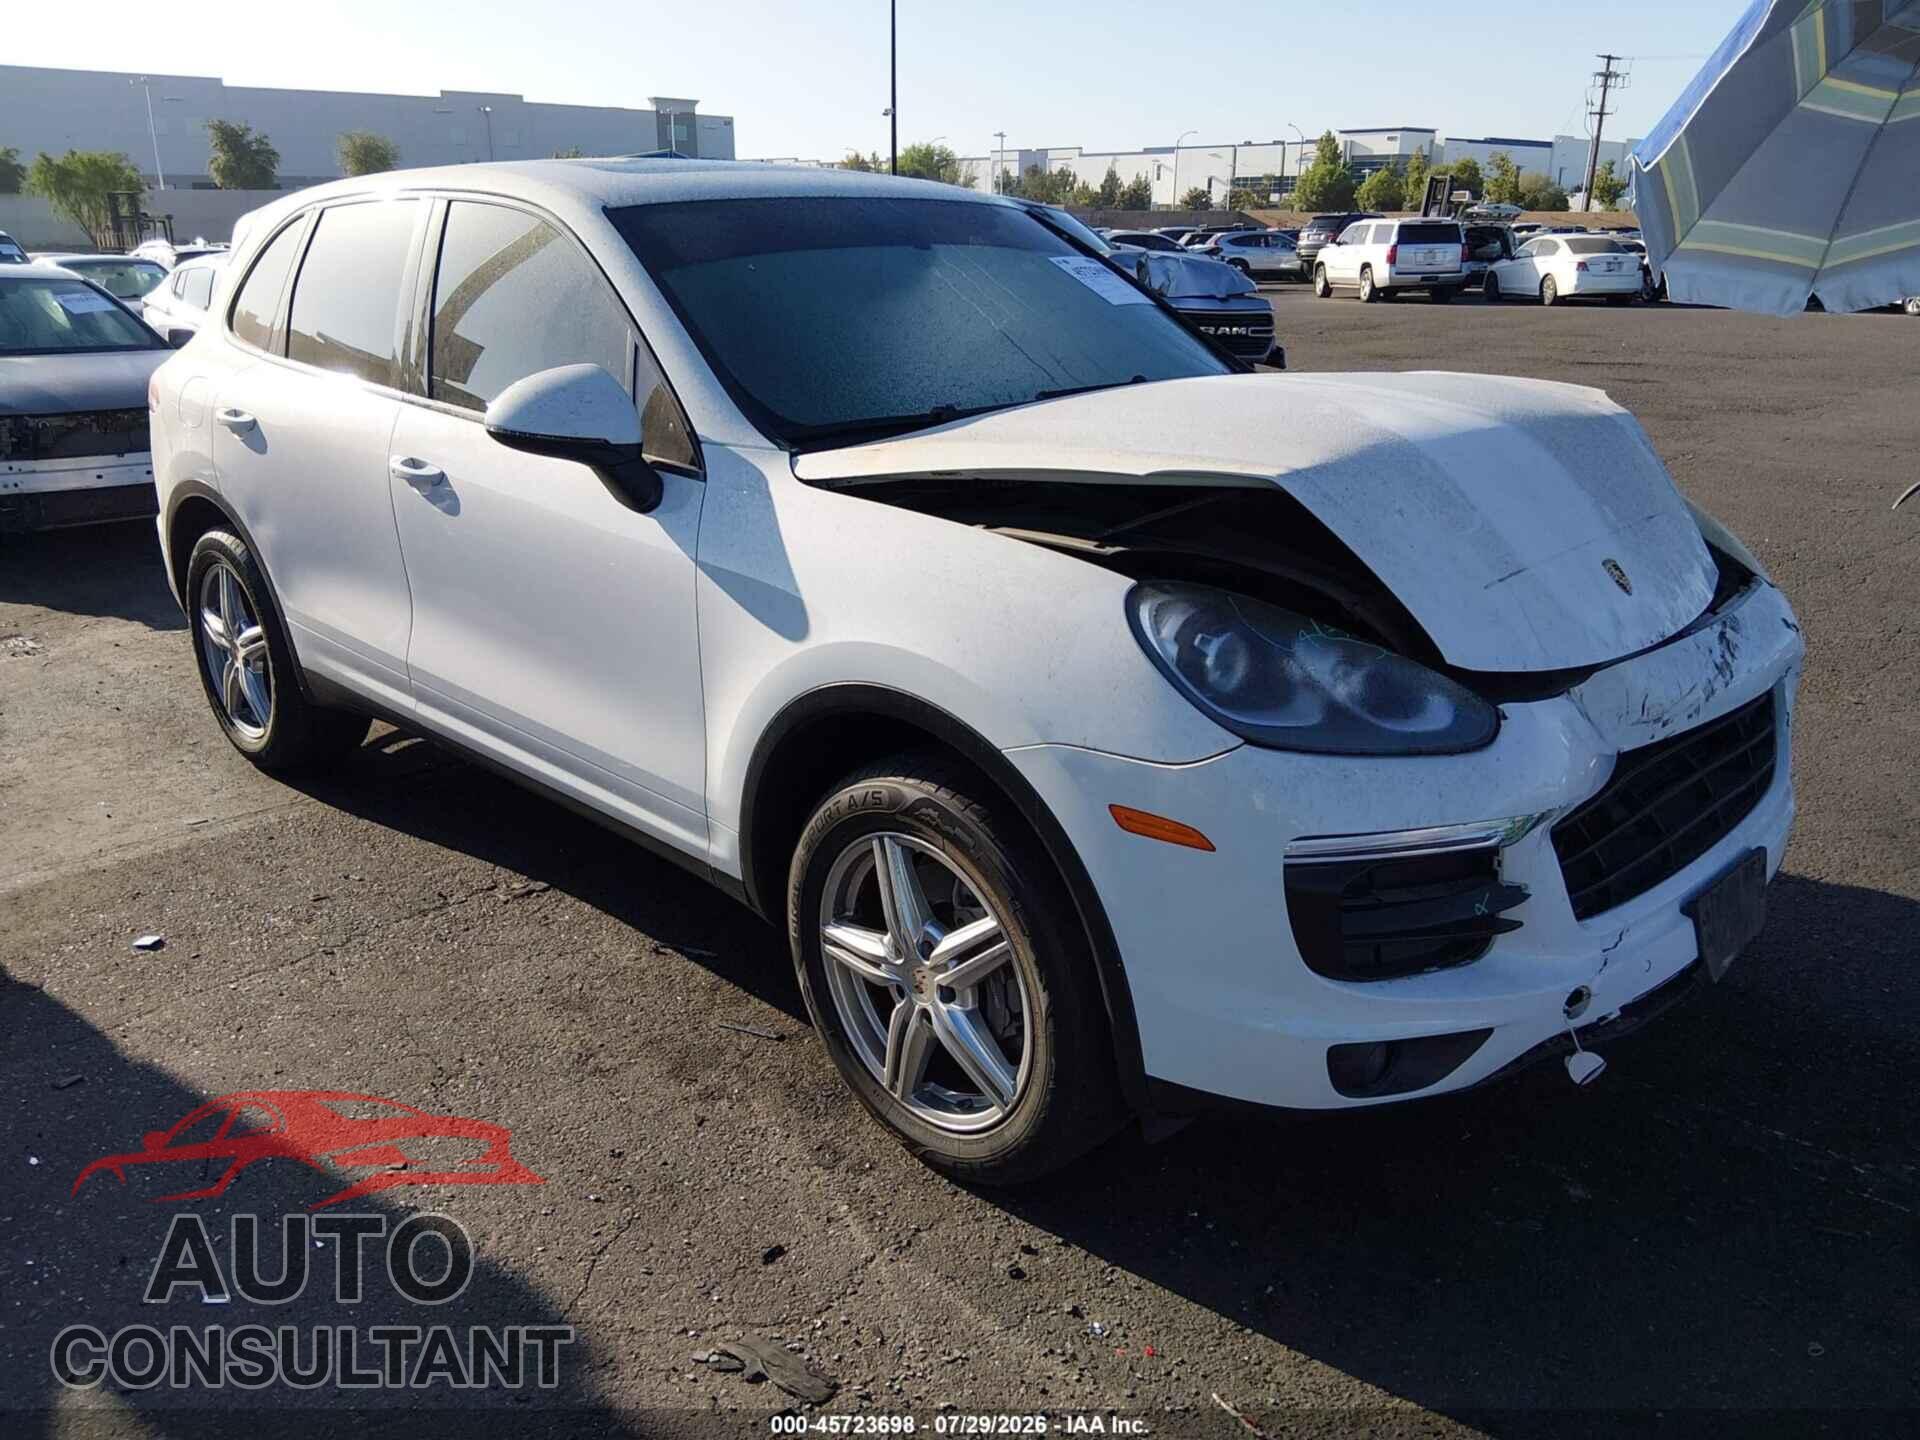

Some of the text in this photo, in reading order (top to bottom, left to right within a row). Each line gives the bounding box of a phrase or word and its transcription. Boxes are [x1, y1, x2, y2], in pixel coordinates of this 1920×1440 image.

[1199, 325, 1247, 336] RAM
[801, 790, 883, 851] SPORT A/S
